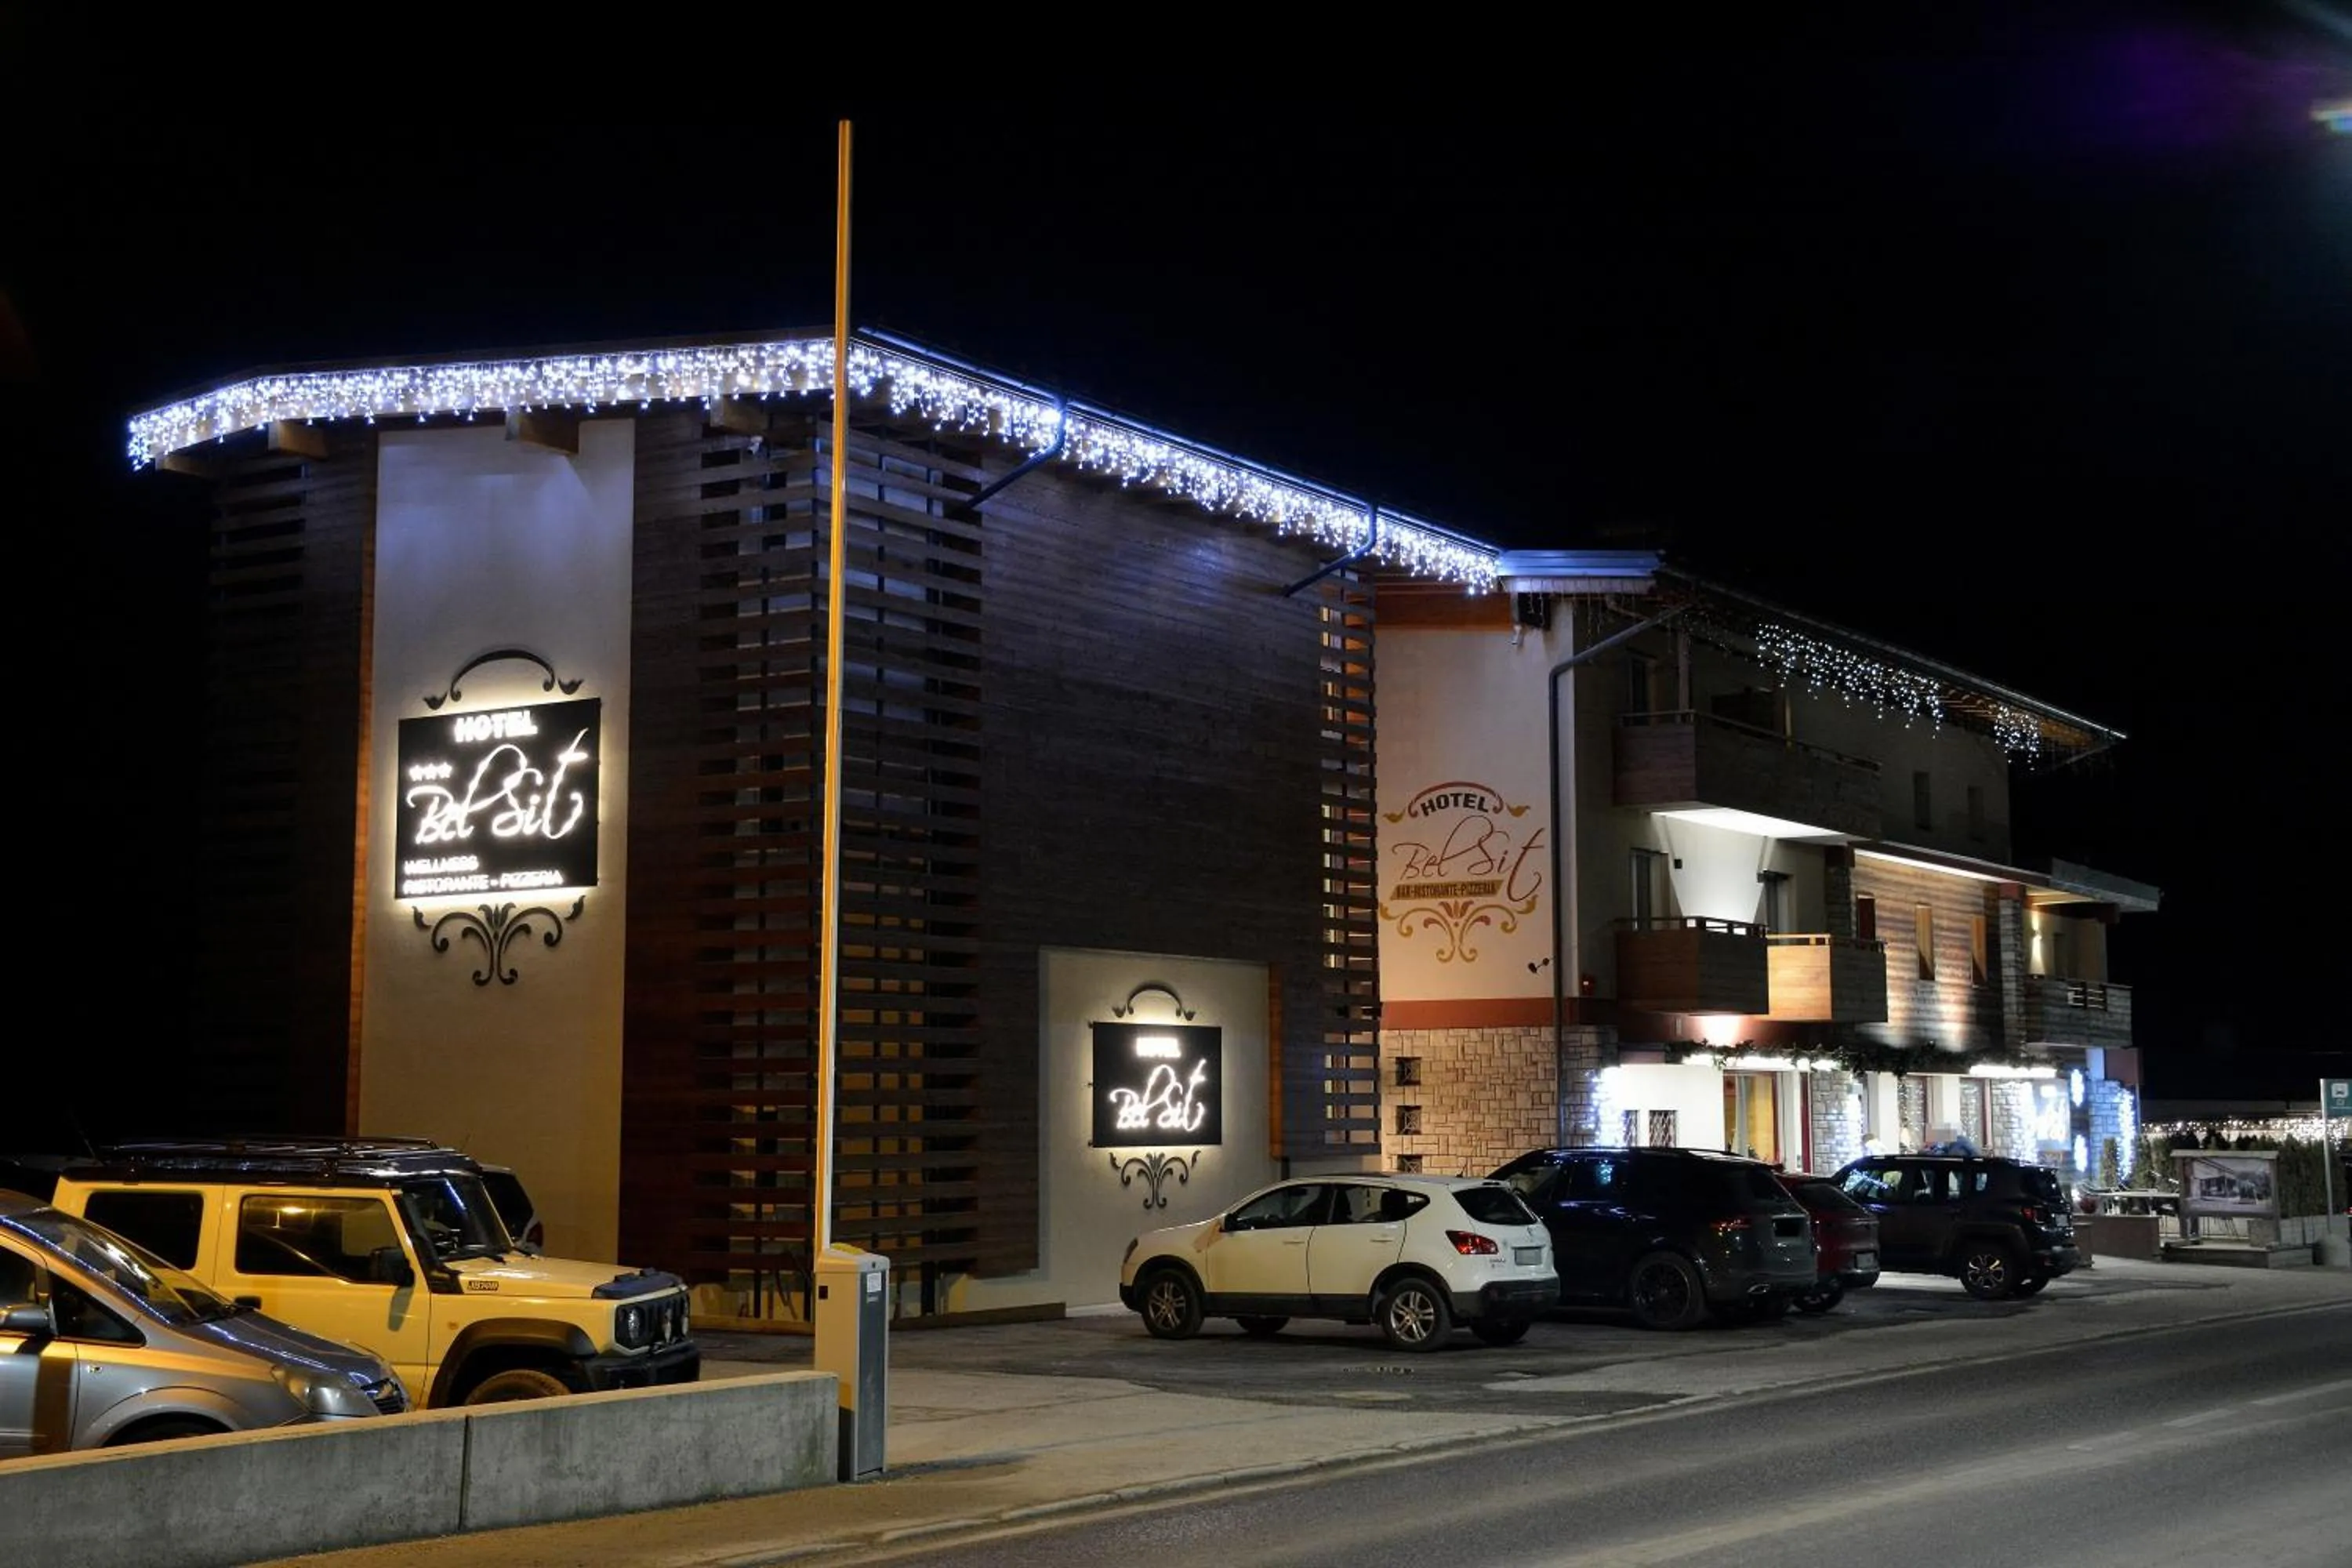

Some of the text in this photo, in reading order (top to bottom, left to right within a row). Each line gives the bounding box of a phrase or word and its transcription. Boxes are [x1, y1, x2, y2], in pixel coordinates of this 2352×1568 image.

[454, 710, 538, 742] HOTEL
[407, 728, 589, 844] Bel Sit
[1421, 793, 1489, 816] HOTEL
[1392, 815, 1545, 902] Bel Sit
[1109, 1058, 1206, 1131] Bel Sit
